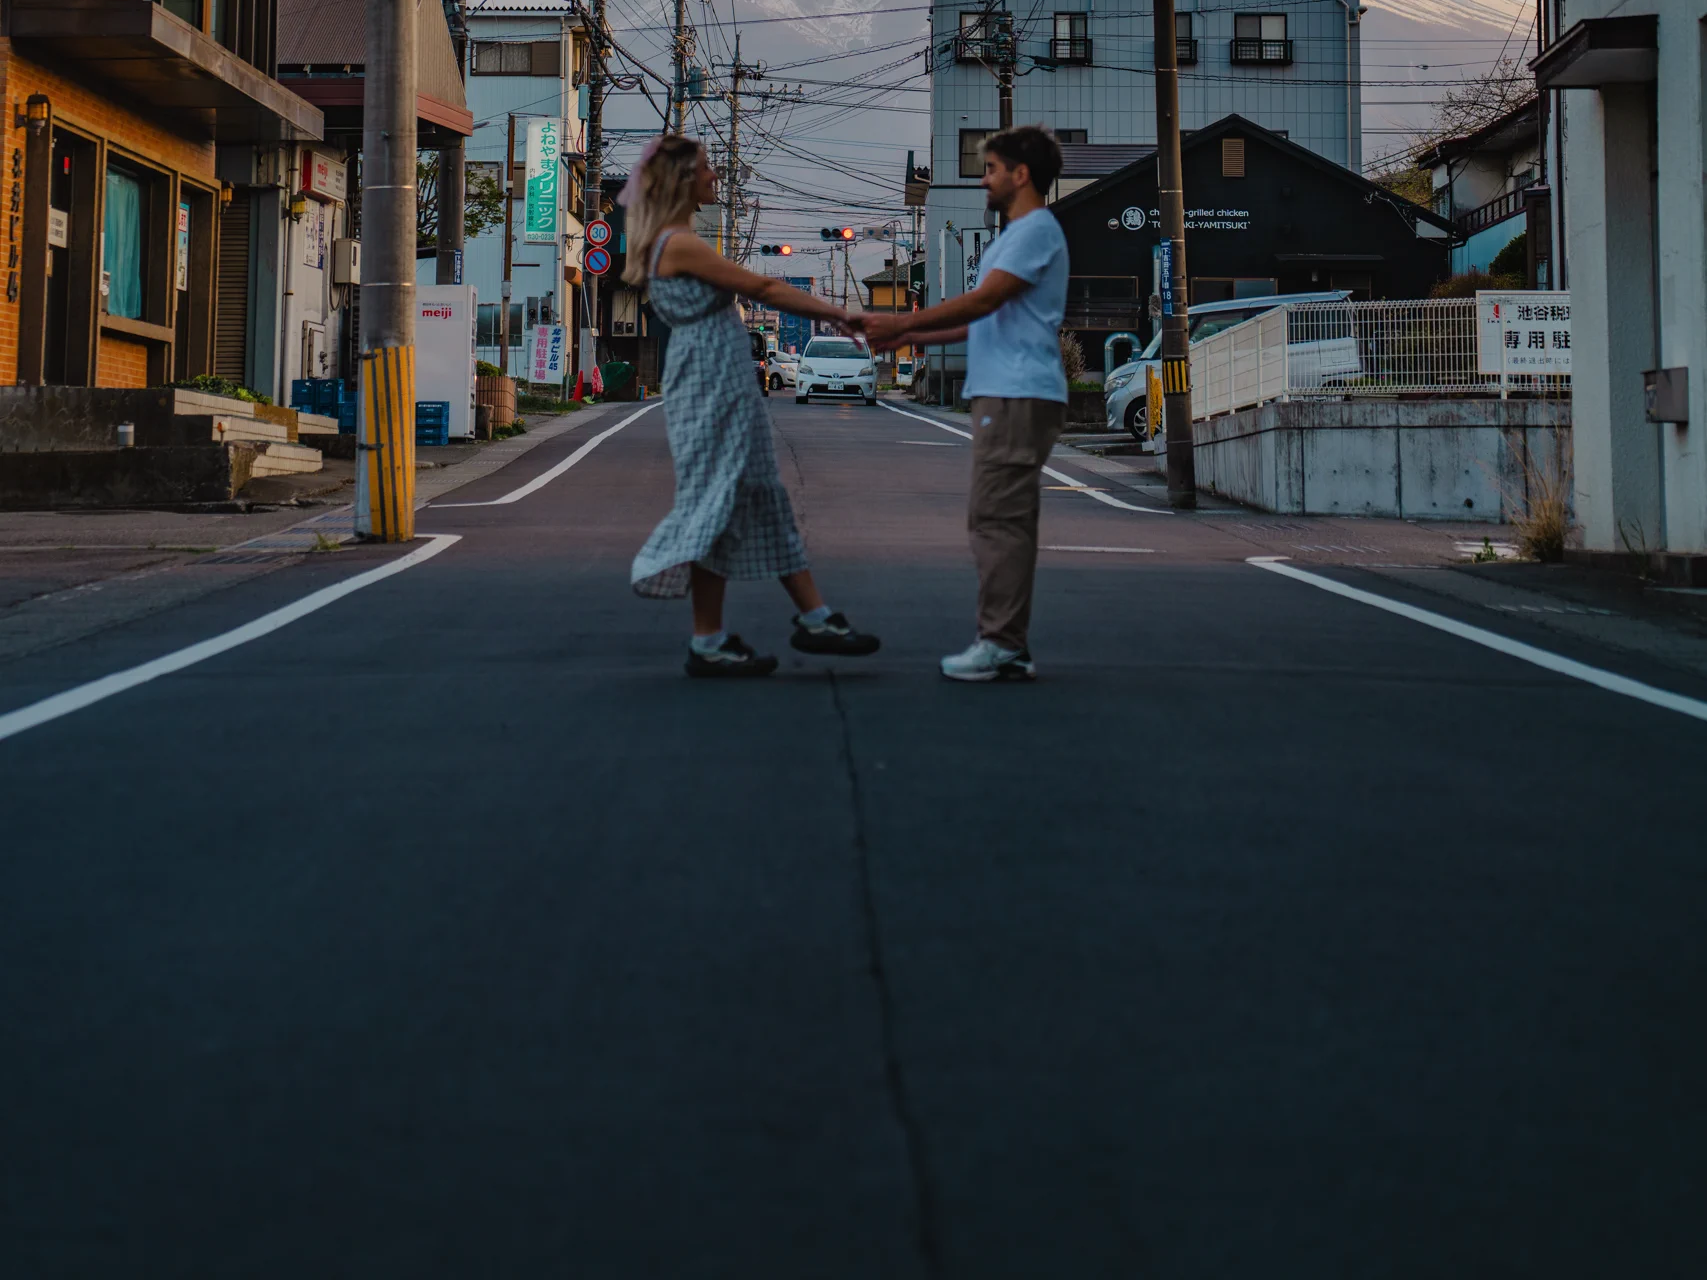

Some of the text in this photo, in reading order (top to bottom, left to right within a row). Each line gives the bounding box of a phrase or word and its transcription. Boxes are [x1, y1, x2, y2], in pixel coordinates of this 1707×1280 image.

[537, 121, 559, 229] よねやまクリニック
[1216, 208, 1249, 217] chicken
[591, 227, 606, 239] 30
[1162, 291, 1172, 300] 18
[422, 307, 452, 320] meiji
[1517, 305, 1571, 322] 池谷税
[1504, 330, 1571, 349] 専用駐
[534, 327, 548, 380] 専用駐車場
[548, 328, 562, 371] 北井ビル45
